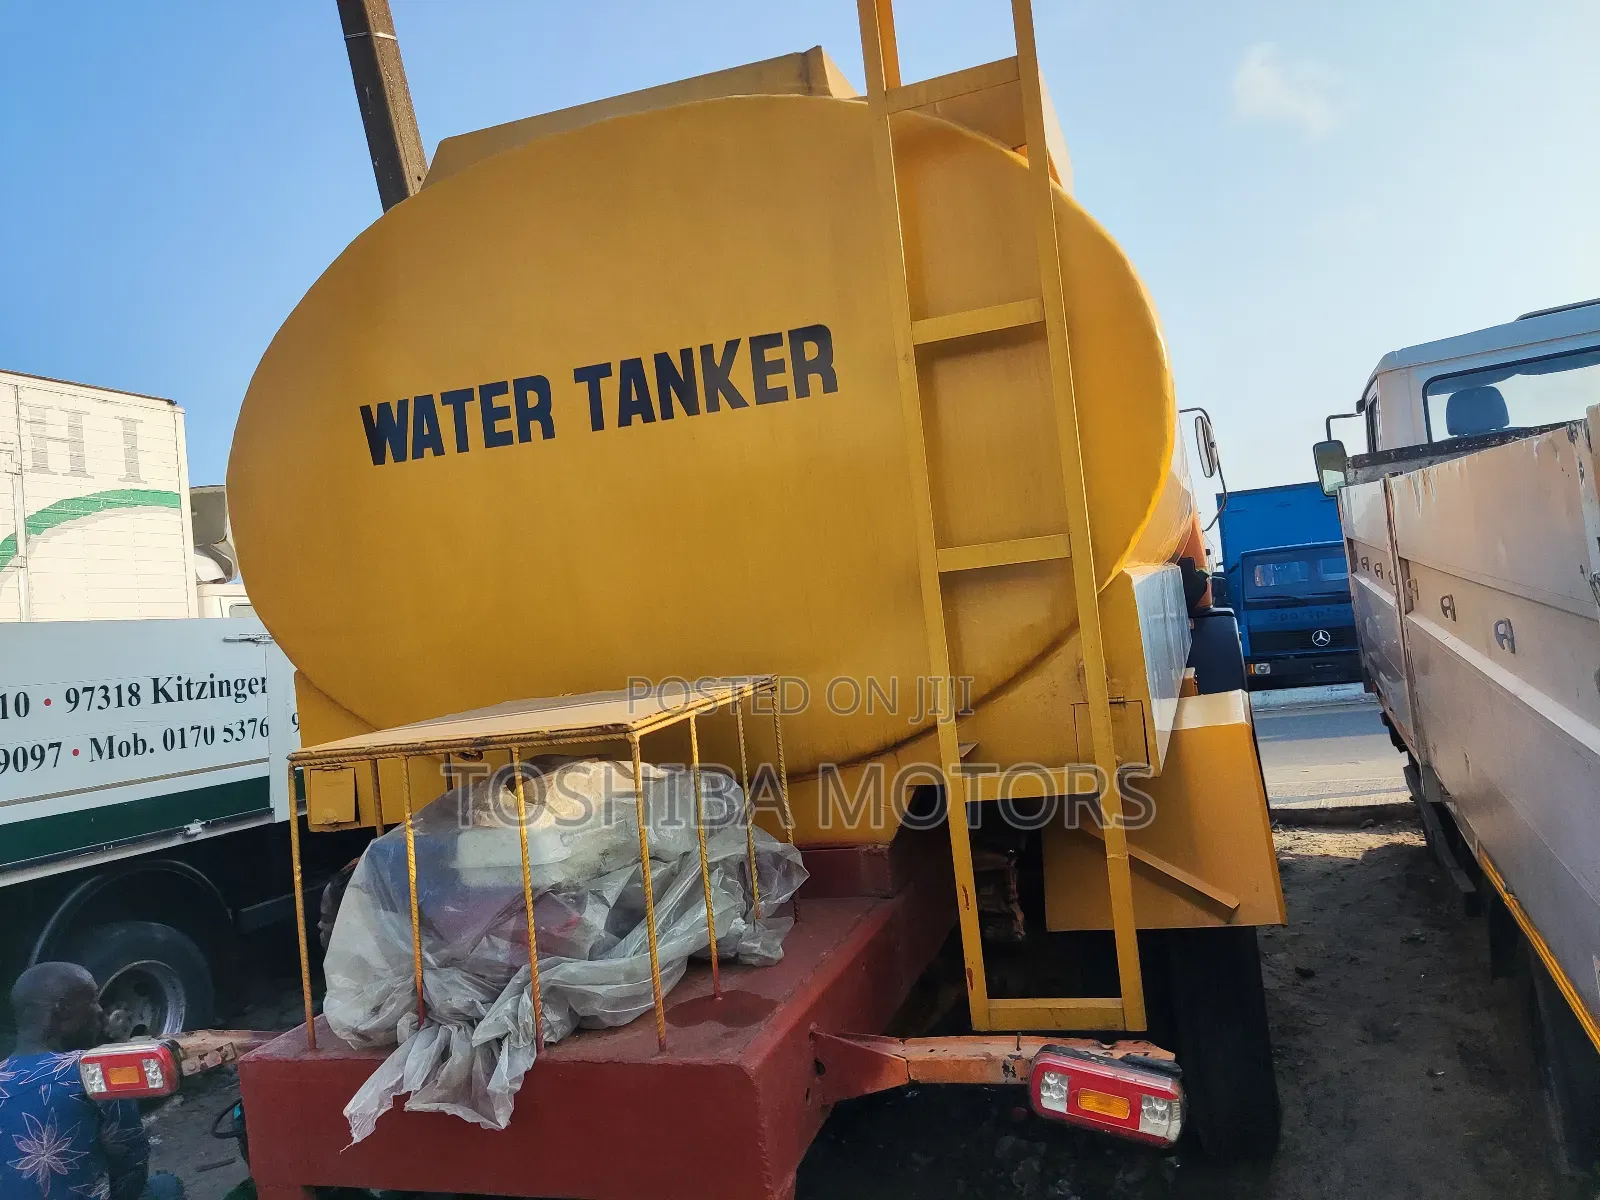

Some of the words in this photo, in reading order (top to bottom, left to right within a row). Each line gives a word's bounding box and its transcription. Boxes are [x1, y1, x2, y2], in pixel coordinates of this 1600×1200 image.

[359, 374, 555, 466] WATER
[573, 324, 838, 432] TANKER
[65, 682, 141, 714] 97318
[88, 732, 155, 763] Mob.
[162, 725, 215, 752] 0170
